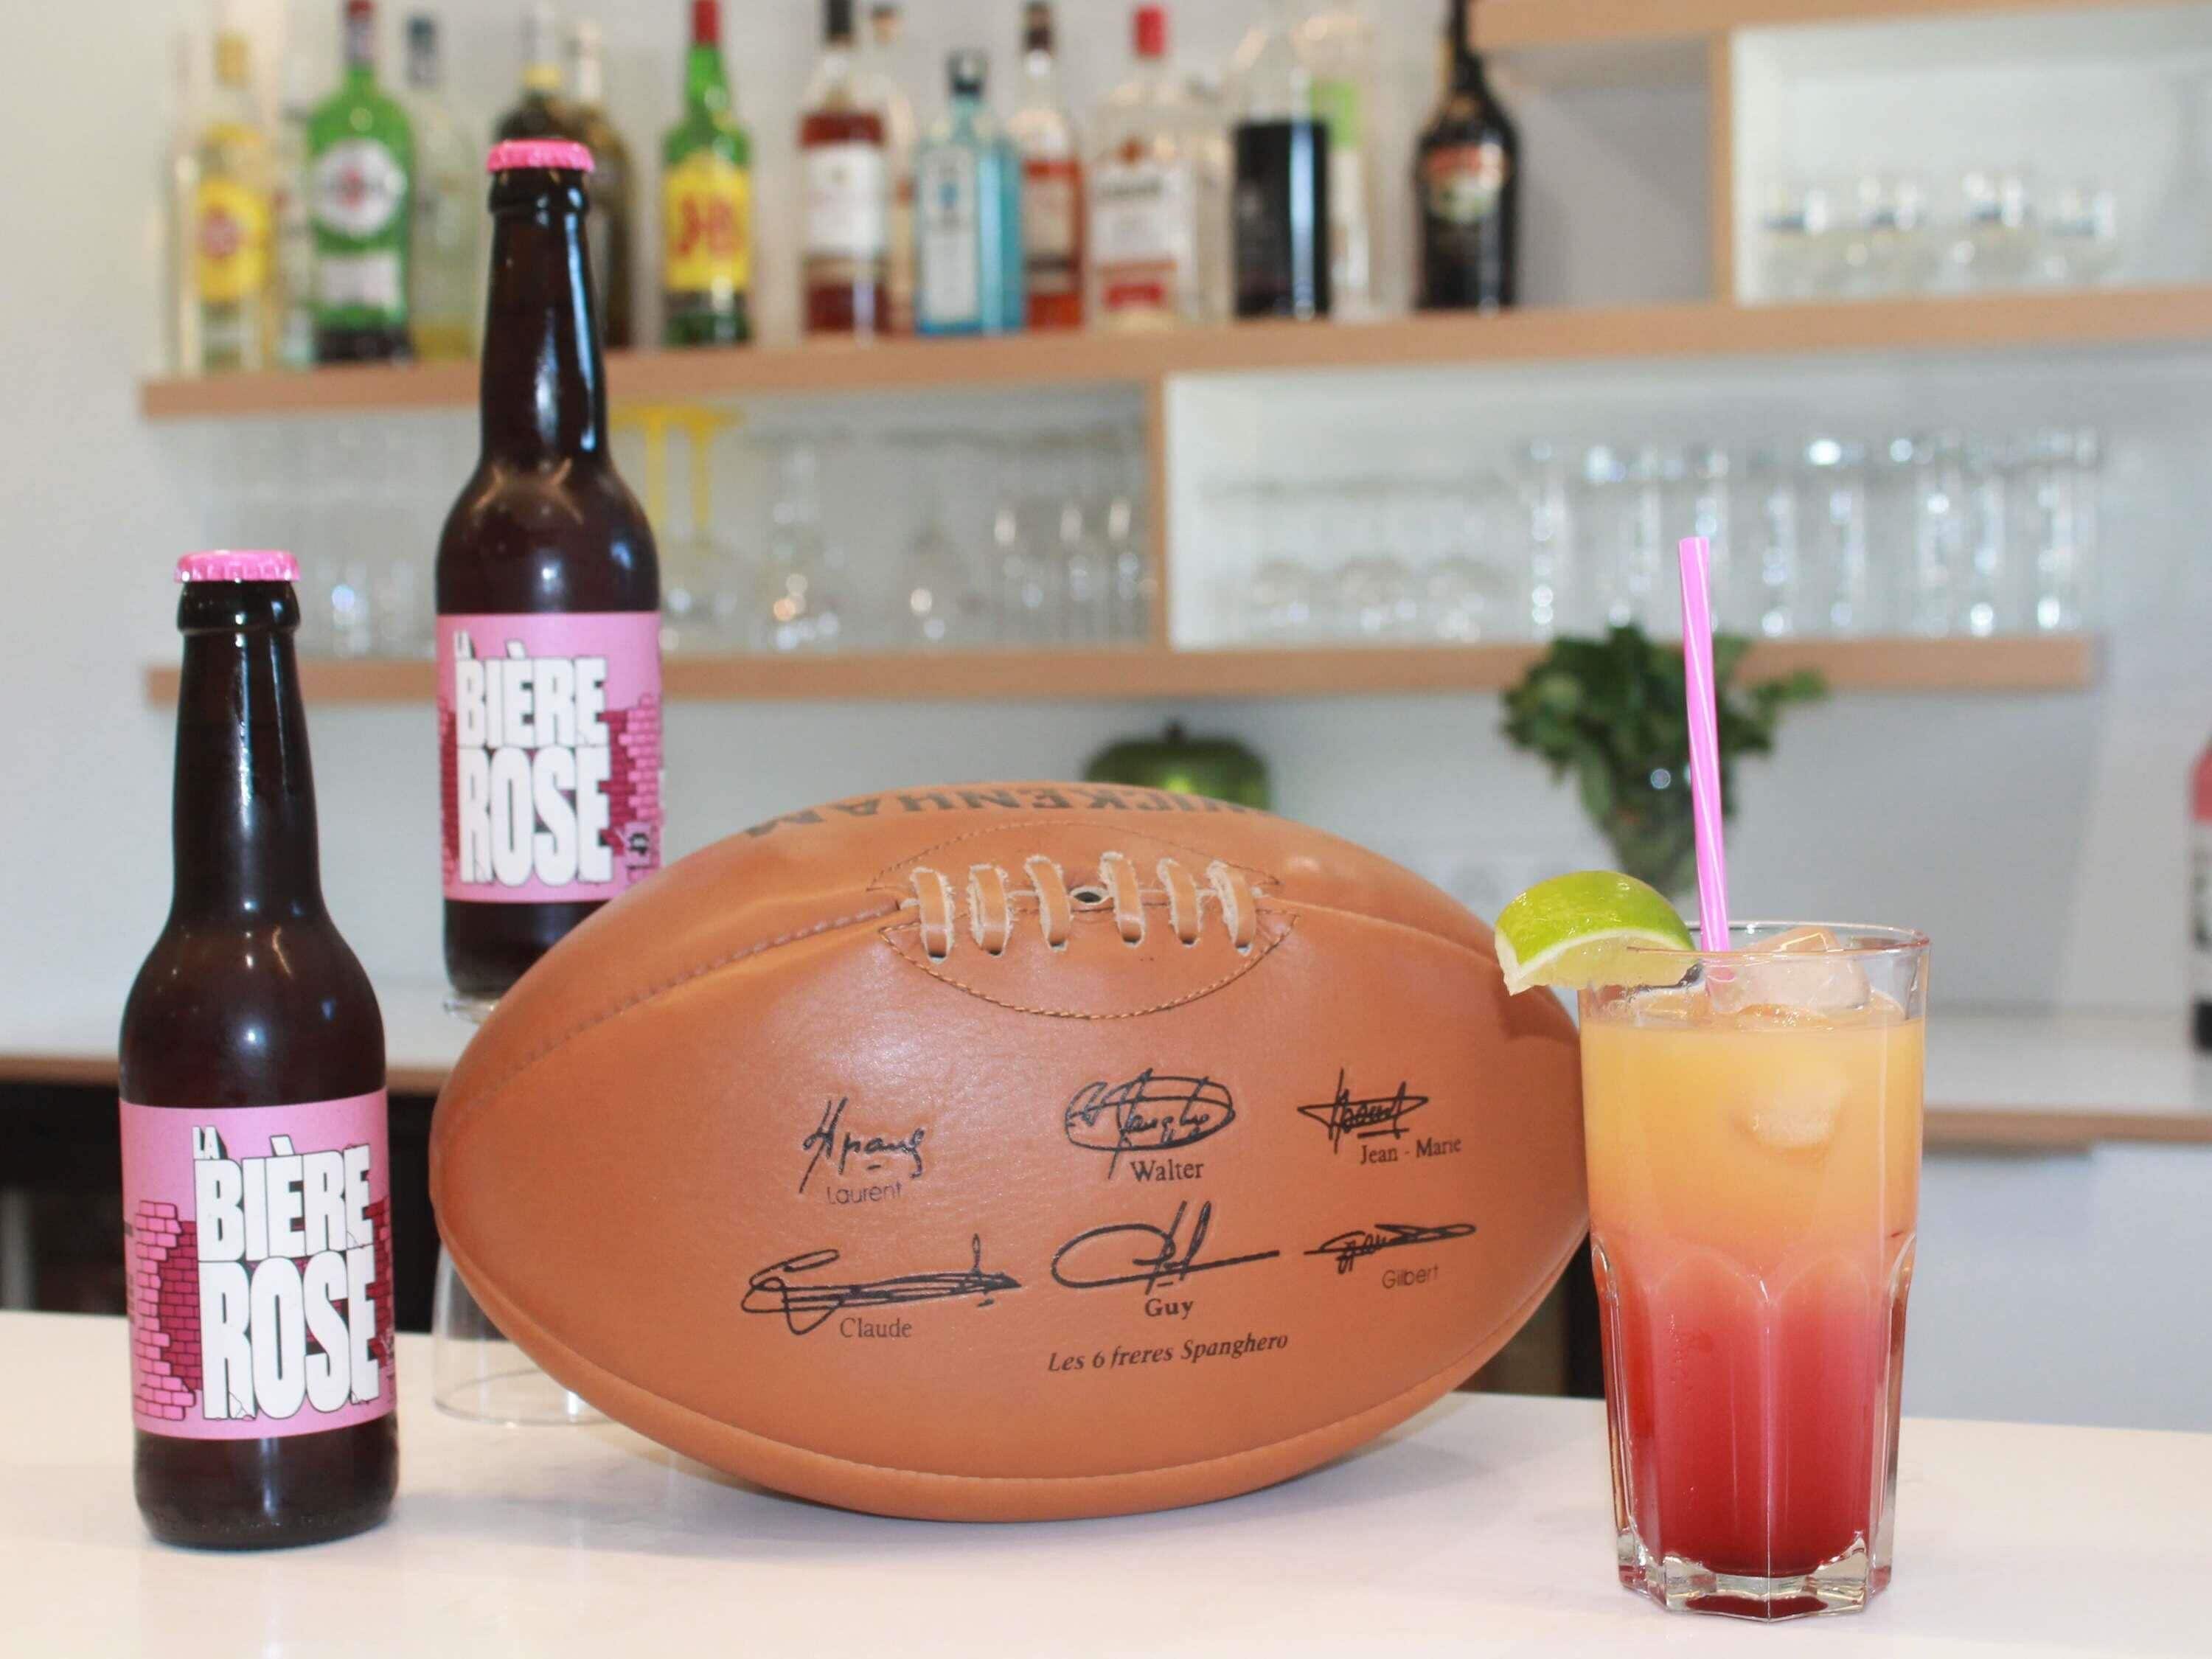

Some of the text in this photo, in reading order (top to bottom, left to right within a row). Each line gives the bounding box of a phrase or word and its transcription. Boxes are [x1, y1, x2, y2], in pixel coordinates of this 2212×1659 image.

[456, 639, 611, 748] BIÈRE
[457, 745, 613, 887] ROSE
[192, 1125, 227, 1159] LA
[1360, 1144, 1399, 1165] Jean
[1416, 1136, 1462, 1158] Marie
[1130, 1158, 1205, 1181] Walter
[193, 1135, 375, 1262] BIÈRE
[826, 1180, 903, 1206] Laurent
[1381, 1263, 1439, 1290] Gilbert
[1144, 1296, 1194, 1320] Guy
[198, 1244, 380, 1420] ROSE
[839, 1317, 913, 1339] Claude
[1047, 1332, 1289, 1372] Les 6 freres Spanghero
